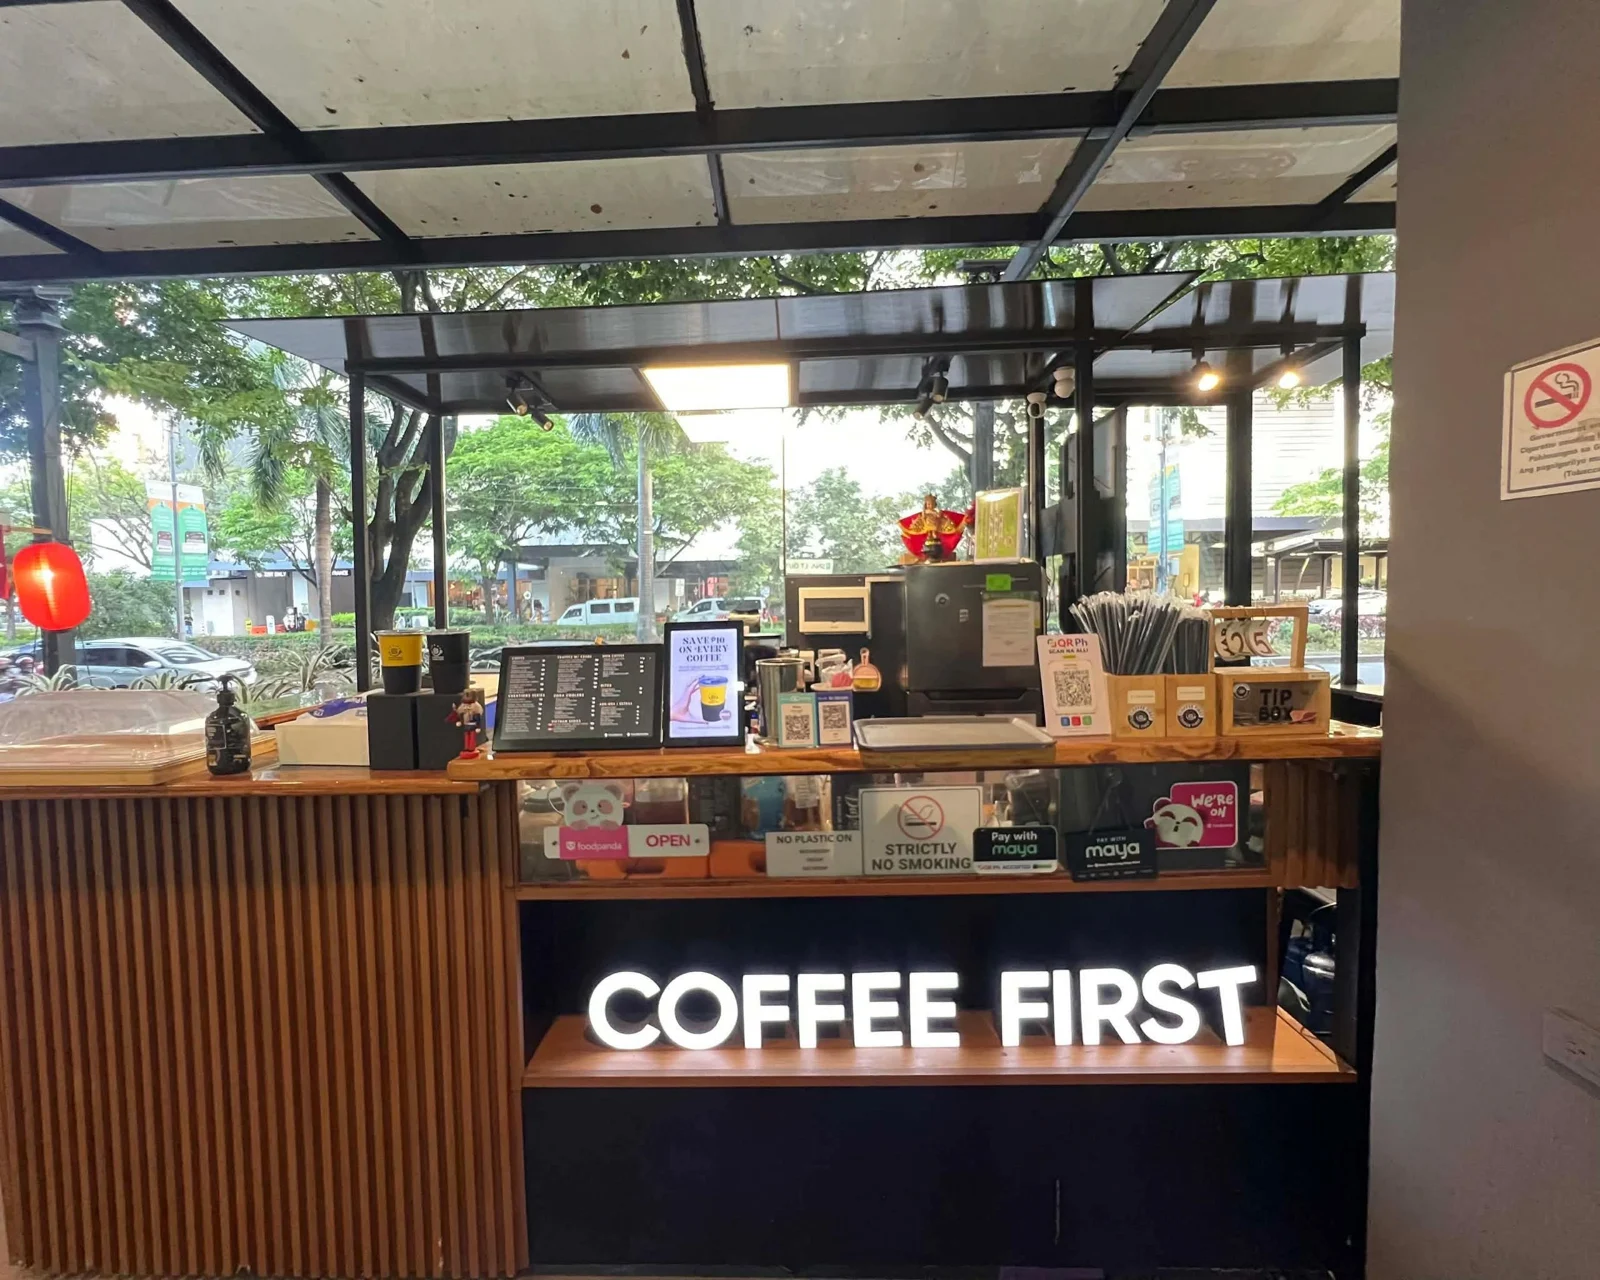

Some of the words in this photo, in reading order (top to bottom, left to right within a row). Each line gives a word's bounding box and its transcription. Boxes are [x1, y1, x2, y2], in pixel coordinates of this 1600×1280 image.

[683, 636, 710, 645] SAVE
[1058, 639, 1074, 647] QR
[1075, 638, 1088, 646] Ph
[679, 646, 692, 654] ON
[686, 654, 722, 662] COFFEE
[1260, 689, 1292, 705] TIP
[1258, 706, 1293, 721] BOX
[646, 834, 691, 847] OPEN
[776, 835, 793, 844] NO
[795, 834, 835, 844] PLASTIC
[836, 833, 853, 842] ON
[991, 832, 1011, 843] Pay
[1013, 831, 1038, 841] with
[577, 841, 623, 852] foodpanda
[885, 843, 957, 856] STRICTLY
[992, 844, 1038, 857] maya
[1085, 842, 1140, 860] maya
[872, 859, 894, 871] NO
[898, 857, 971, 870] SMOKING
[588, 971, 961, 1050] COFFEE
[1000, 964, 1258, 1048] FIRST
